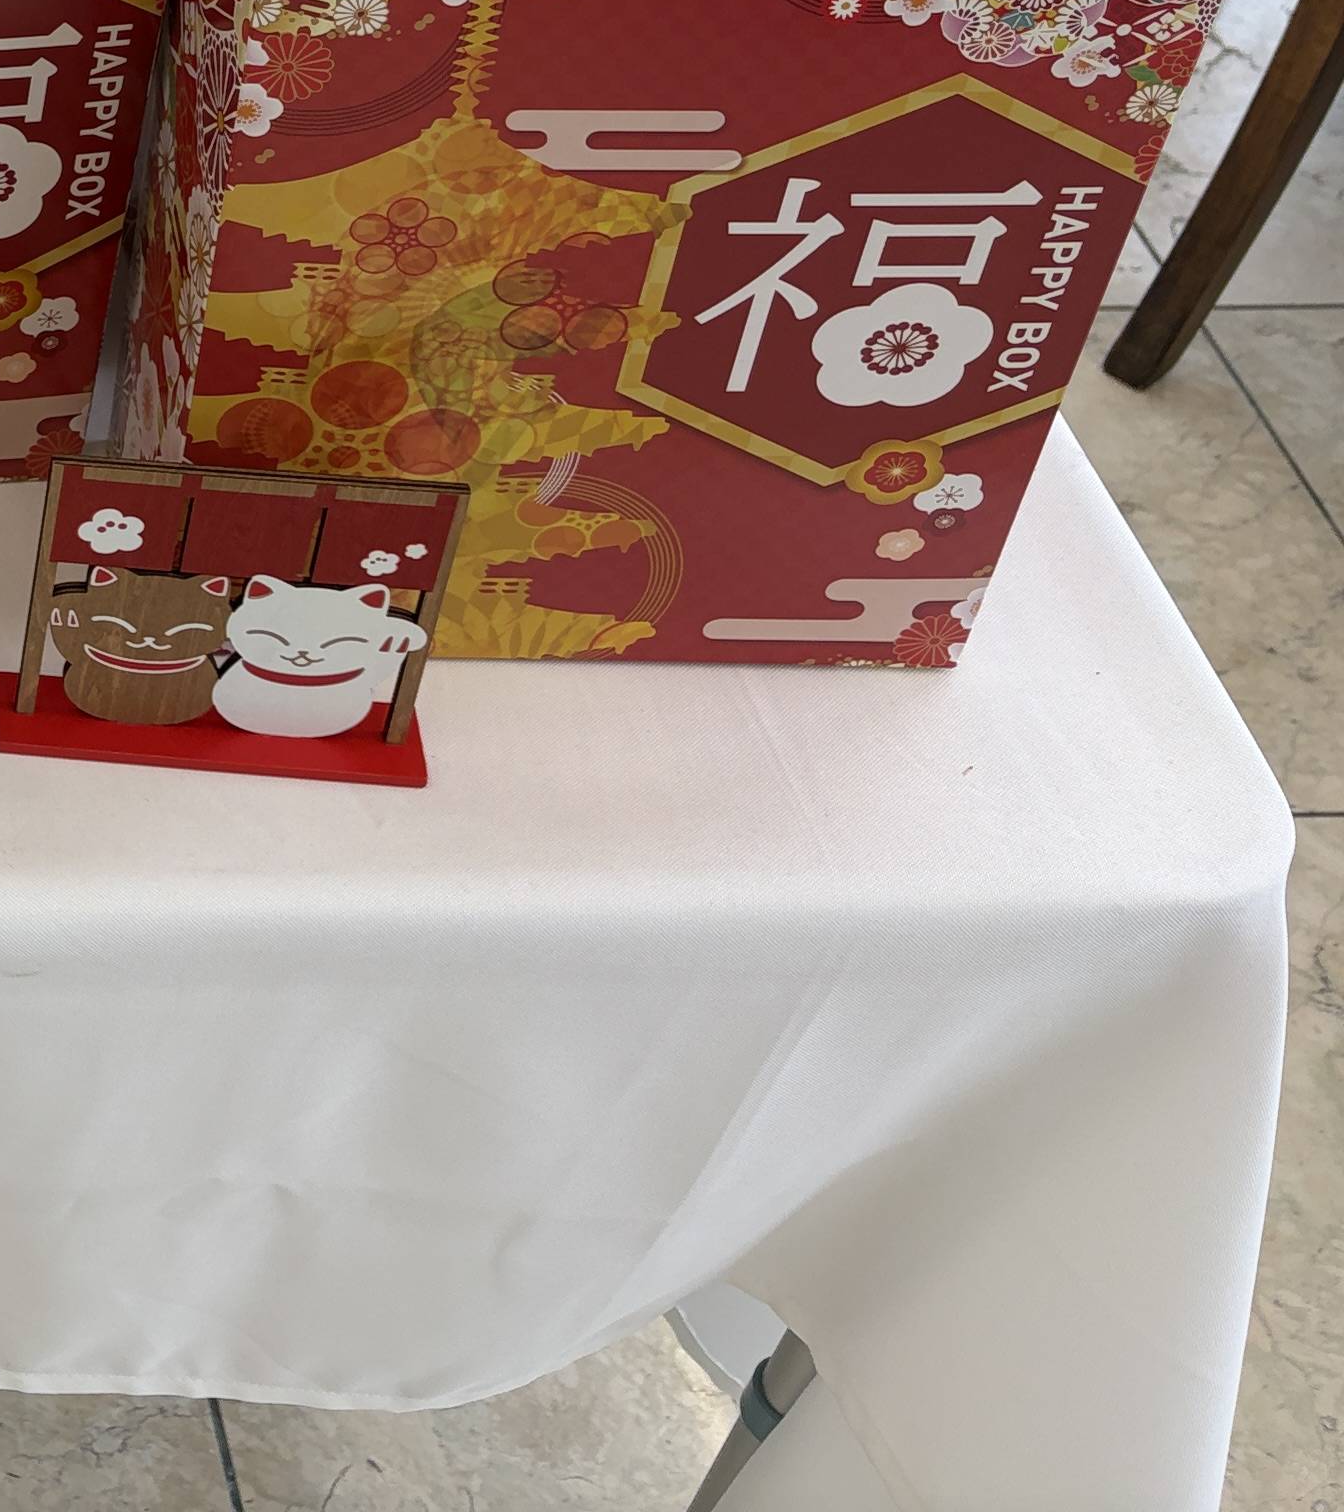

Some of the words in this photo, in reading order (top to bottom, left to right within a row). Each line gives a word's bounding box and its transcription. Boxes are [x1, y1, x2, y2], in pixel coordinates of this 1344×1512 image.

[76, 23, 134, 147] HAPPY
[64, 149, 113, 223] BOX
[1024, 183, 1104, 312] HAPPY
[694, 177, 1045, 407] 福
[986, 319, 1054, 394] BOX
